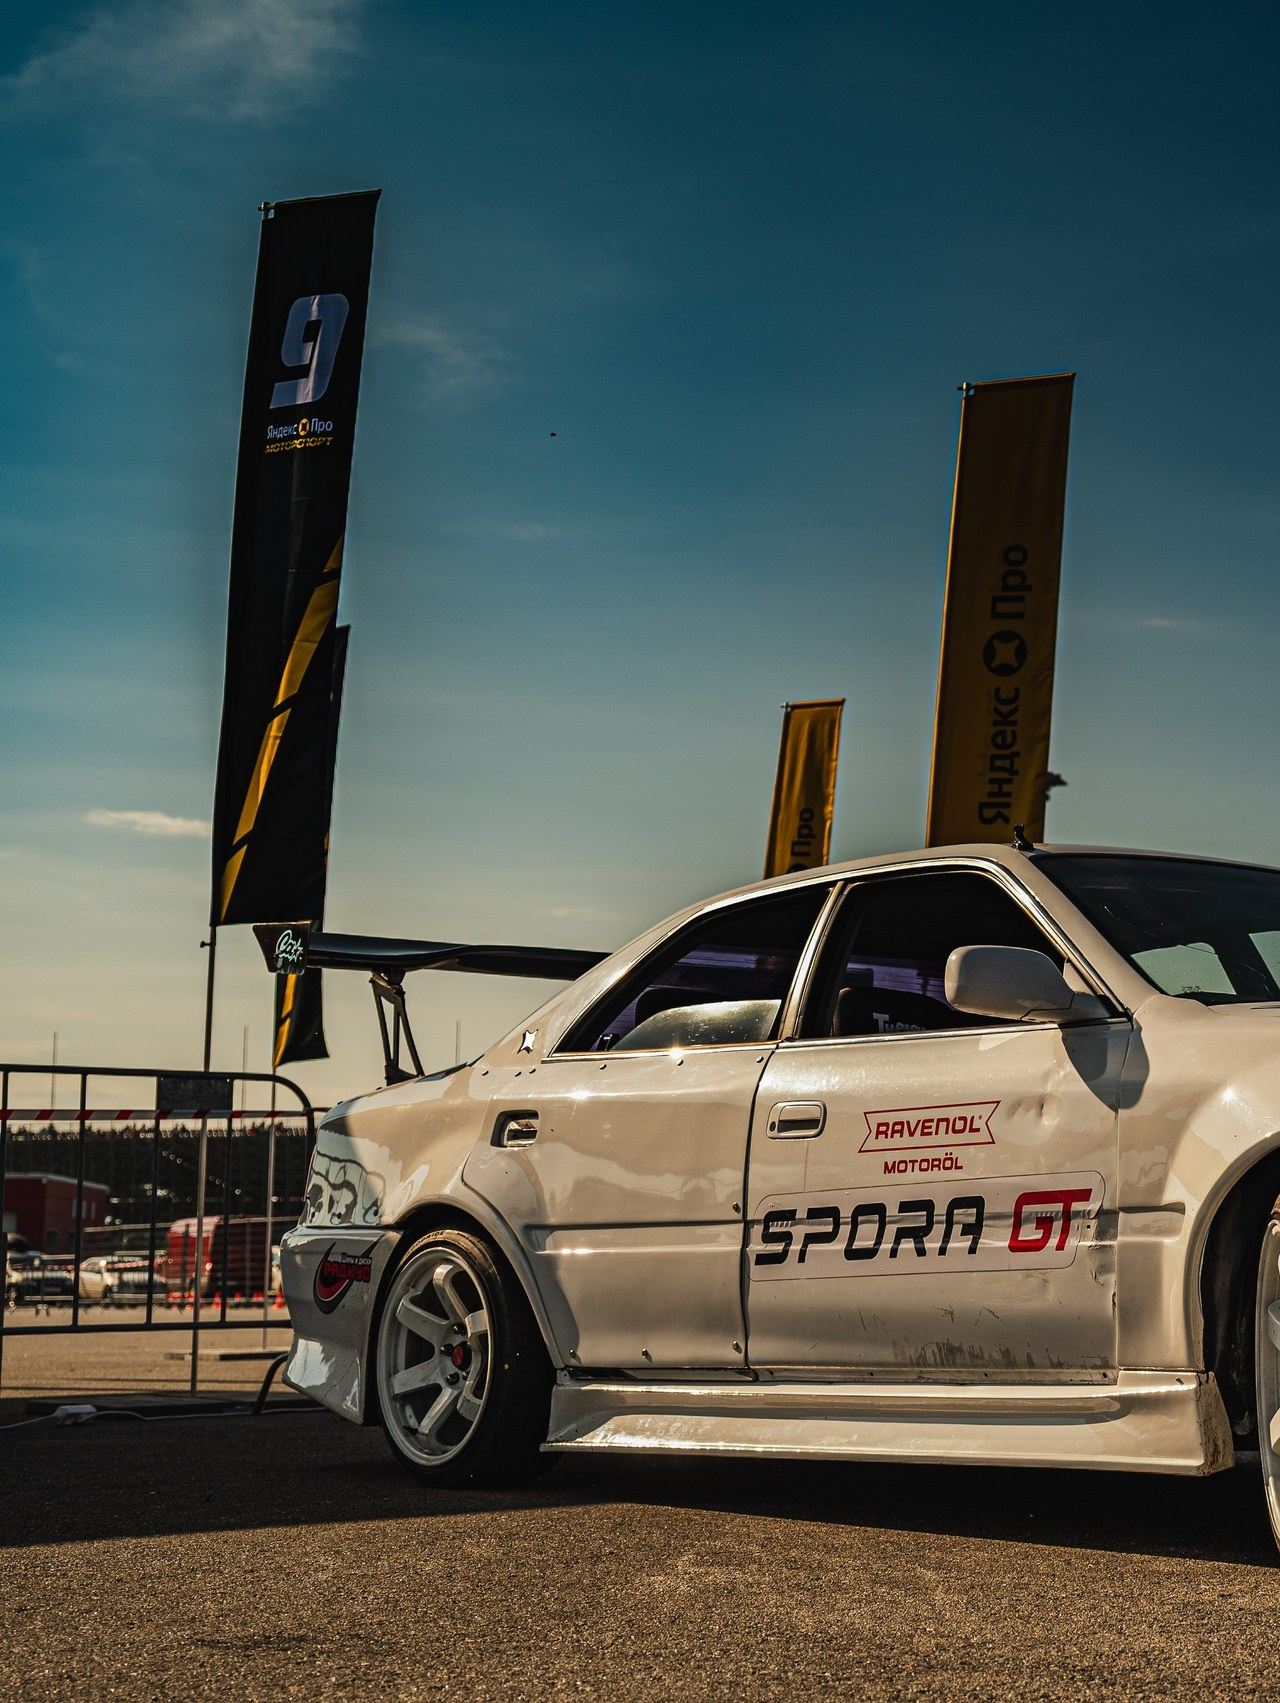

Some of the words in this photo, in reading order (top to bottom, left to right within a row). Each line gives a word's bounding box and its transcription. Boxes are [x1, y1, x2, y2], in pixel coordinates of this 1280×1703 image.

[269, 293, 349, 409] 9
[265, 436, 334, 453] МОТОРСПОРТ
[267, 423, 298, 440] Яндекс
[310, 418, 333, 434] Про
[990, 544, 1033, 620] Про
[978, 686, 1021, 825] Яндекс
[790, 806, 816, 858] Про
[883, 1152, 964, 1175] MOTORÖL
[754, 1195, 986, 1266] SPORA
[1007, 1187, 1093, 1254] GT
